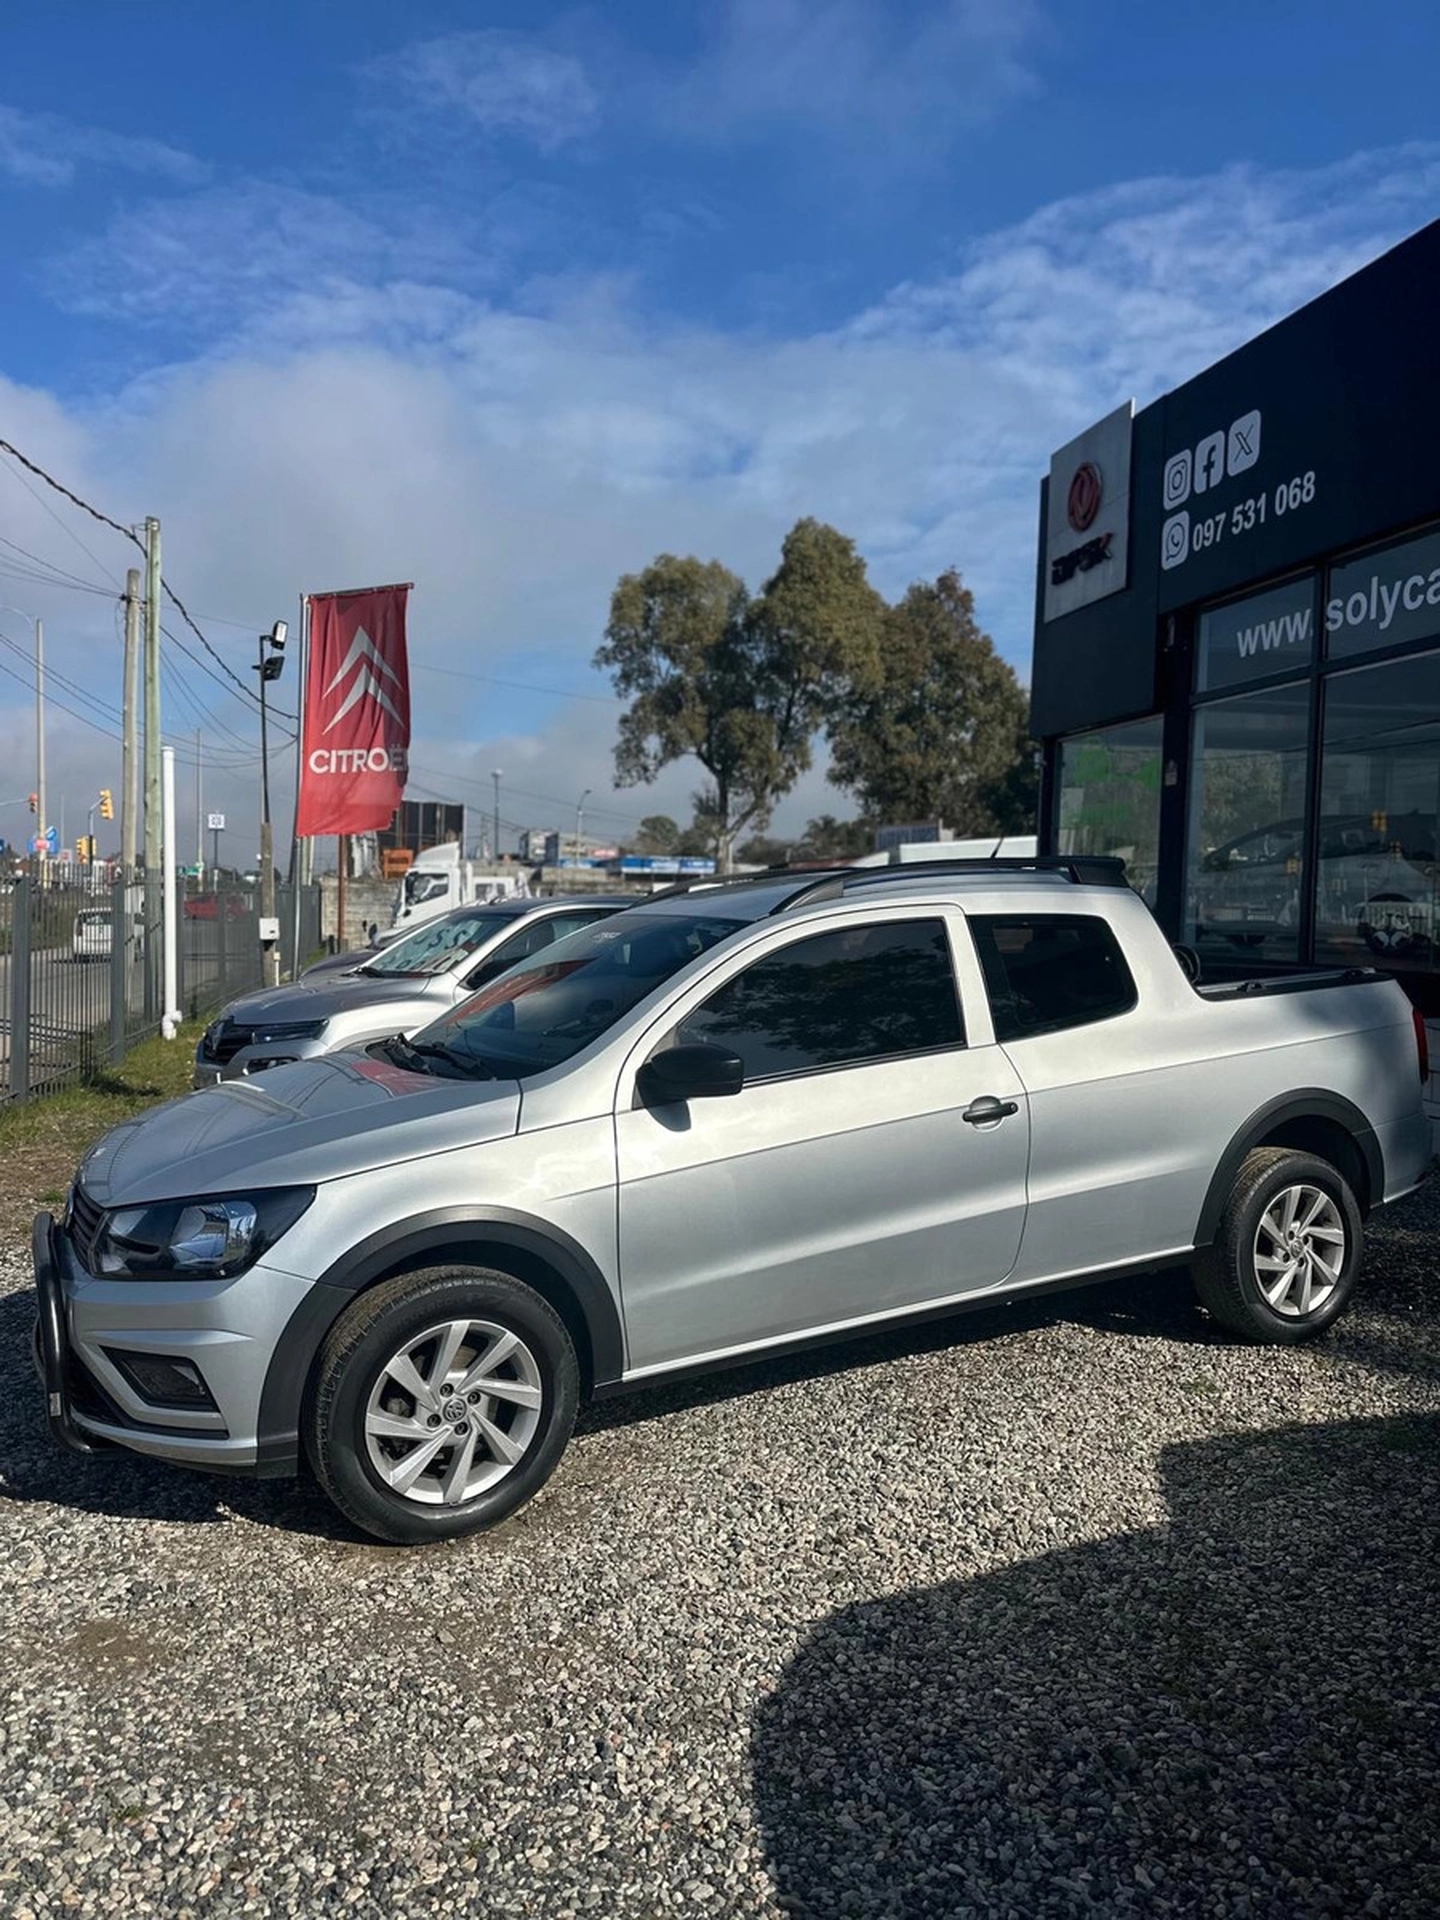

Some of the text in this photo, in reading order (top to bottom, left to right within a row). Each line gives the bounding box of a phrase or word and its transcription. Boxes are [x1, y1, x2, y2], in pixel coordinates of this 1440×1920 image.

[1193, 470, 1315, 551] 097 531 068
[308, 743, 408, 774] CITROË
